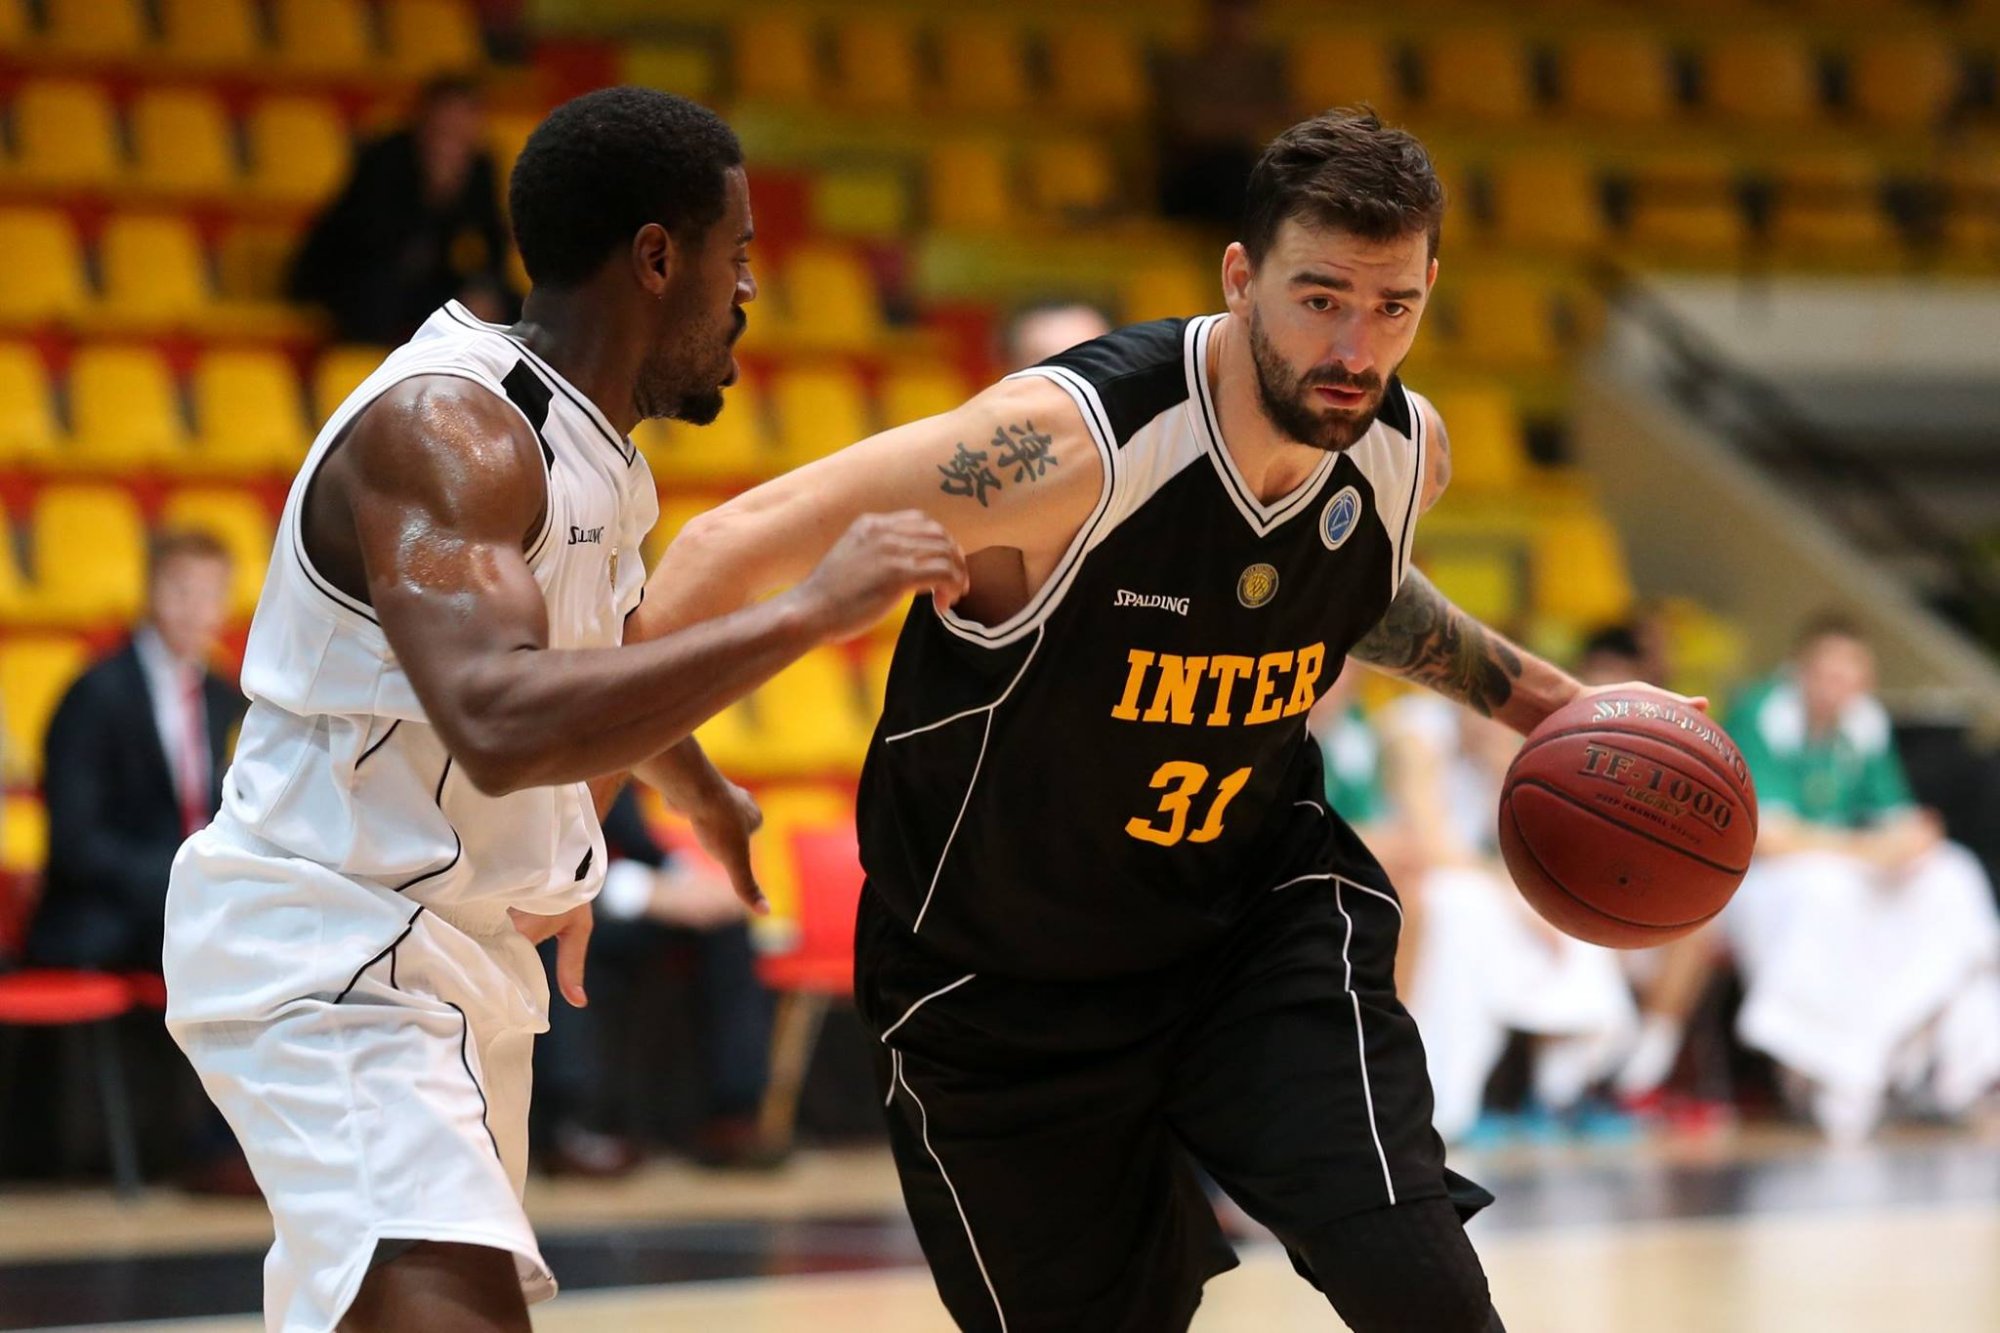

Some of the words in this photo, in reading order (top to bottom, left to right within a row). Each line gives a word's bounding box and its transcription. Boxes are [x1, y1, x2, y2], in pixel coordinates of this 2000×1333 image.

[1114, 589, 1190, 616] SPALDING
[1110, 641, 1326, 727] INTER
[1124, 760, 1253, 847] 31
[1584, 743, 1732, 830] TF-1000
[1623, 802, 1667, 827] CHANNEL
[1624, 785, 1687, 817] LEGACY
